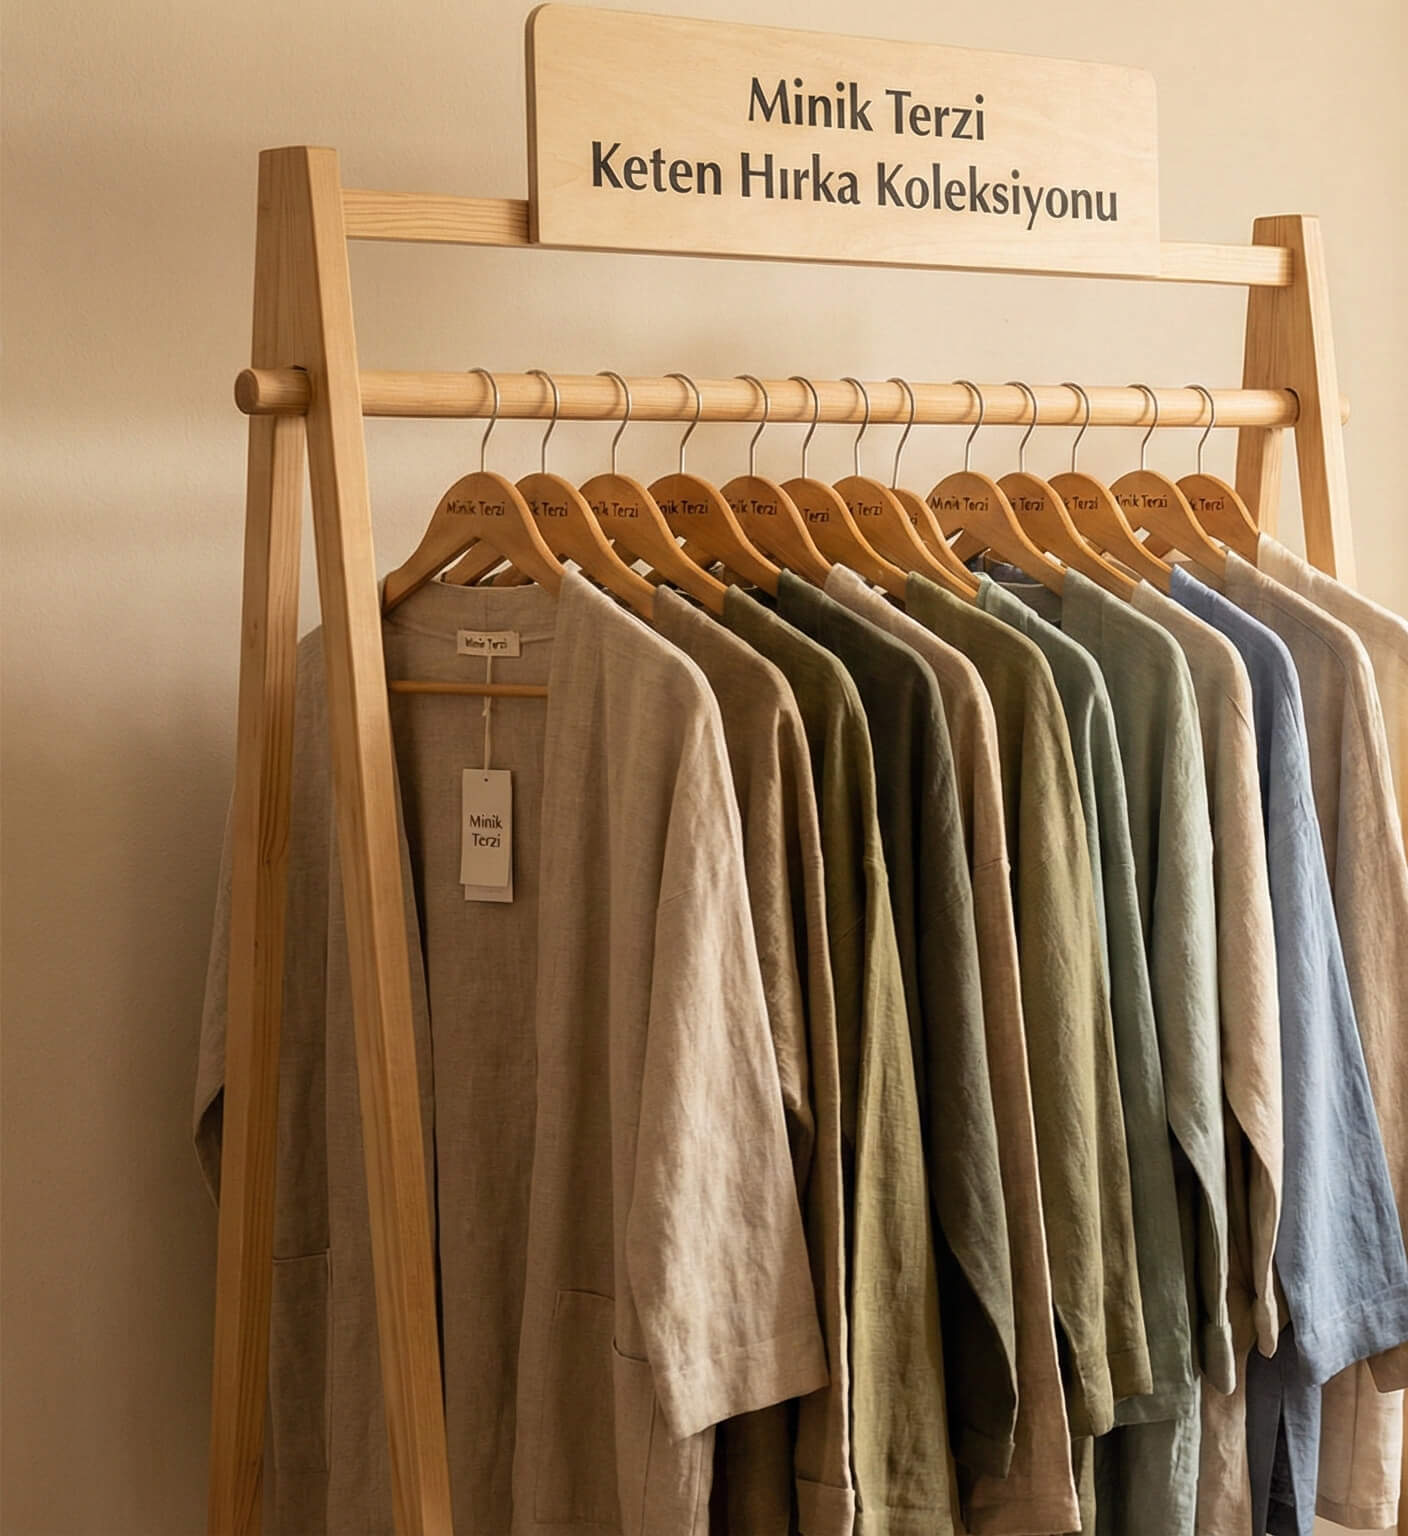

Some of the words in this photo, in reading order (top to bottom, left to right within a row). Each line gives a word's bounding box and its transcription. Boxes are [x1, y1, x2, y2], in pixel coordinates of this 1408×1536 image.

[747, 77, 873, 132] Minik
[885, 89, 985, 141] Terzi
[591, 141, 722, 196] Keten
[740, 152, 860, 206] Hırka
[877, 162, 1118, 231] Koleksiyonu
[480, 502, 505, 516] Terzi
[682, 500, 709, 514] Terzi
[751, 500, 777, 515] Terzi
[1072, 497, 1098, 510] Terzi
[1142, 494, 1168, 509] Terzi
[1200, 497, 1225, 512] Terzi
[543, 502, 569, 517] Terzi
[613, 502, 639, 518] Terzi
[804, 508, 830, 523] Terzi
[858, 502, 883, 517] Terzi
[469, 814, 504, 830] Minik
[472, 832, 502, 848] Terzi
